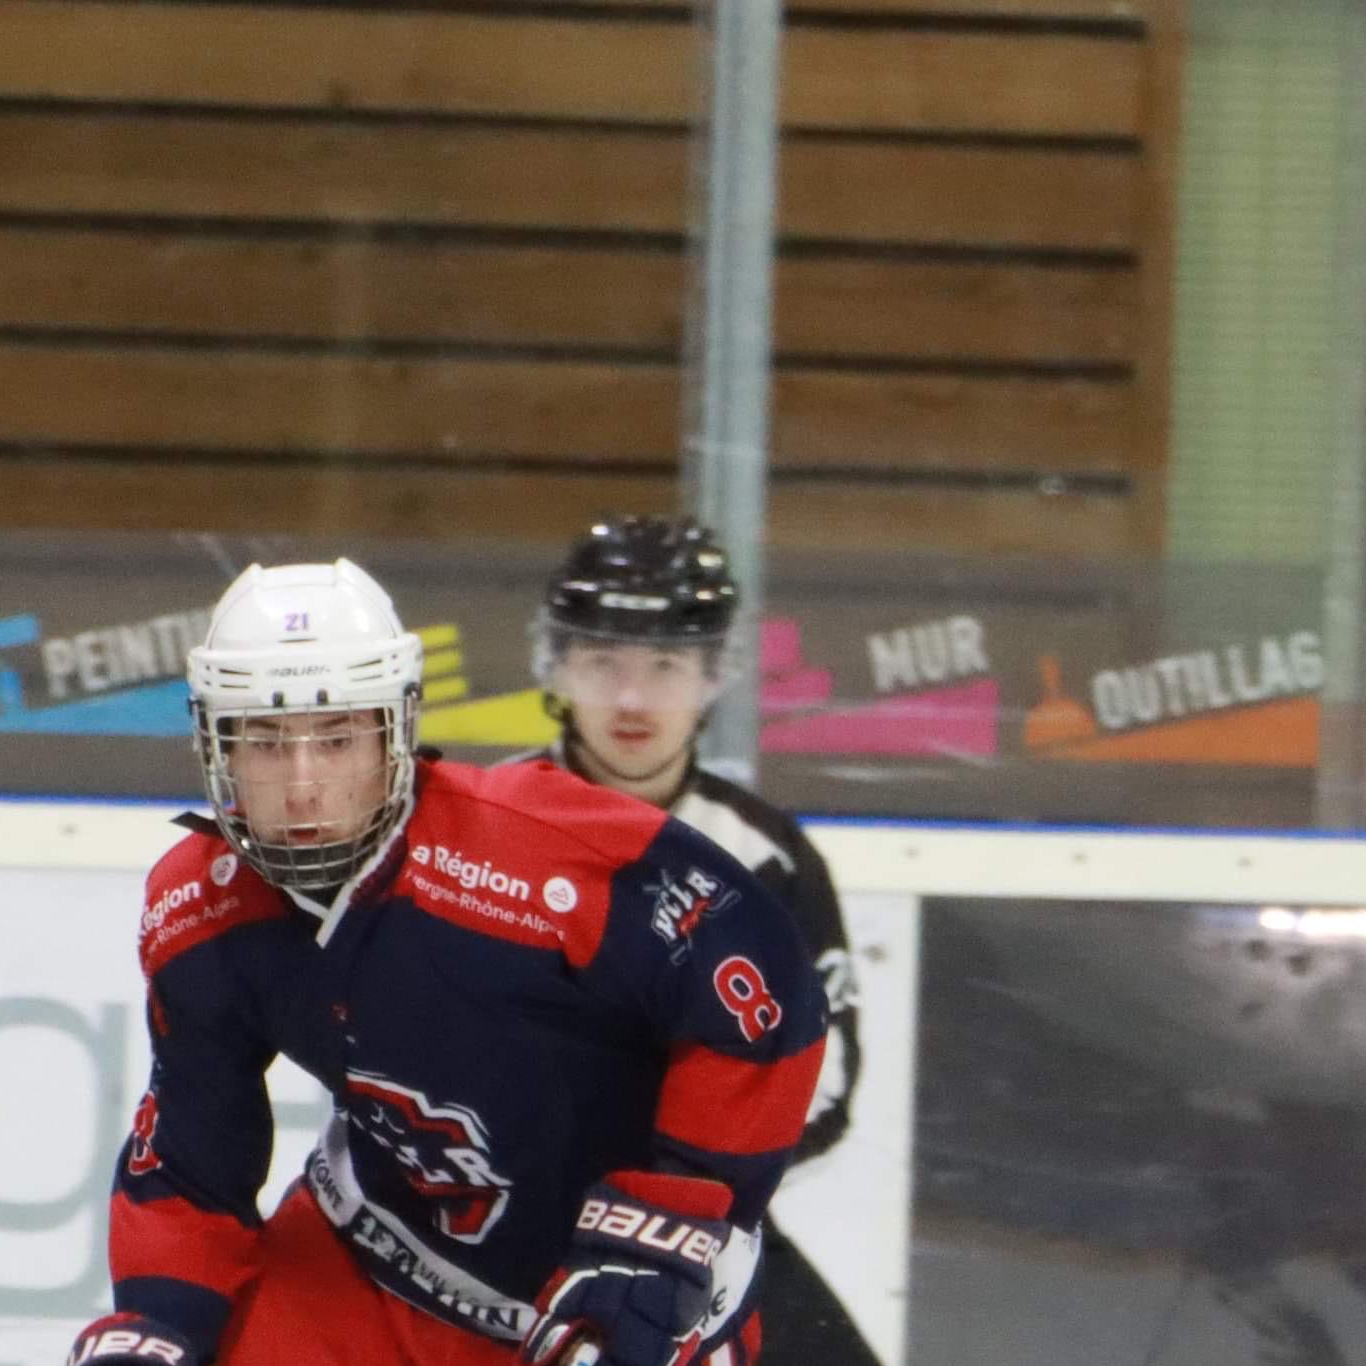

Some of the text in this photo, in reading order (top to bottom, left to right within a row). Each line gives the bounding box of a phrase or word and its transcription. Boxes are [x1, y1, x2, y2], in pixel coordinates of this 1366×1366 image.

[867, 616, 989, 692] MUR
[1090, 631, 1325, 729] OUTILLAG
[141, 880, 202, 936] égion
[411, 845, 531, 902] a Région
[713, 955, 782, 1043] 8
